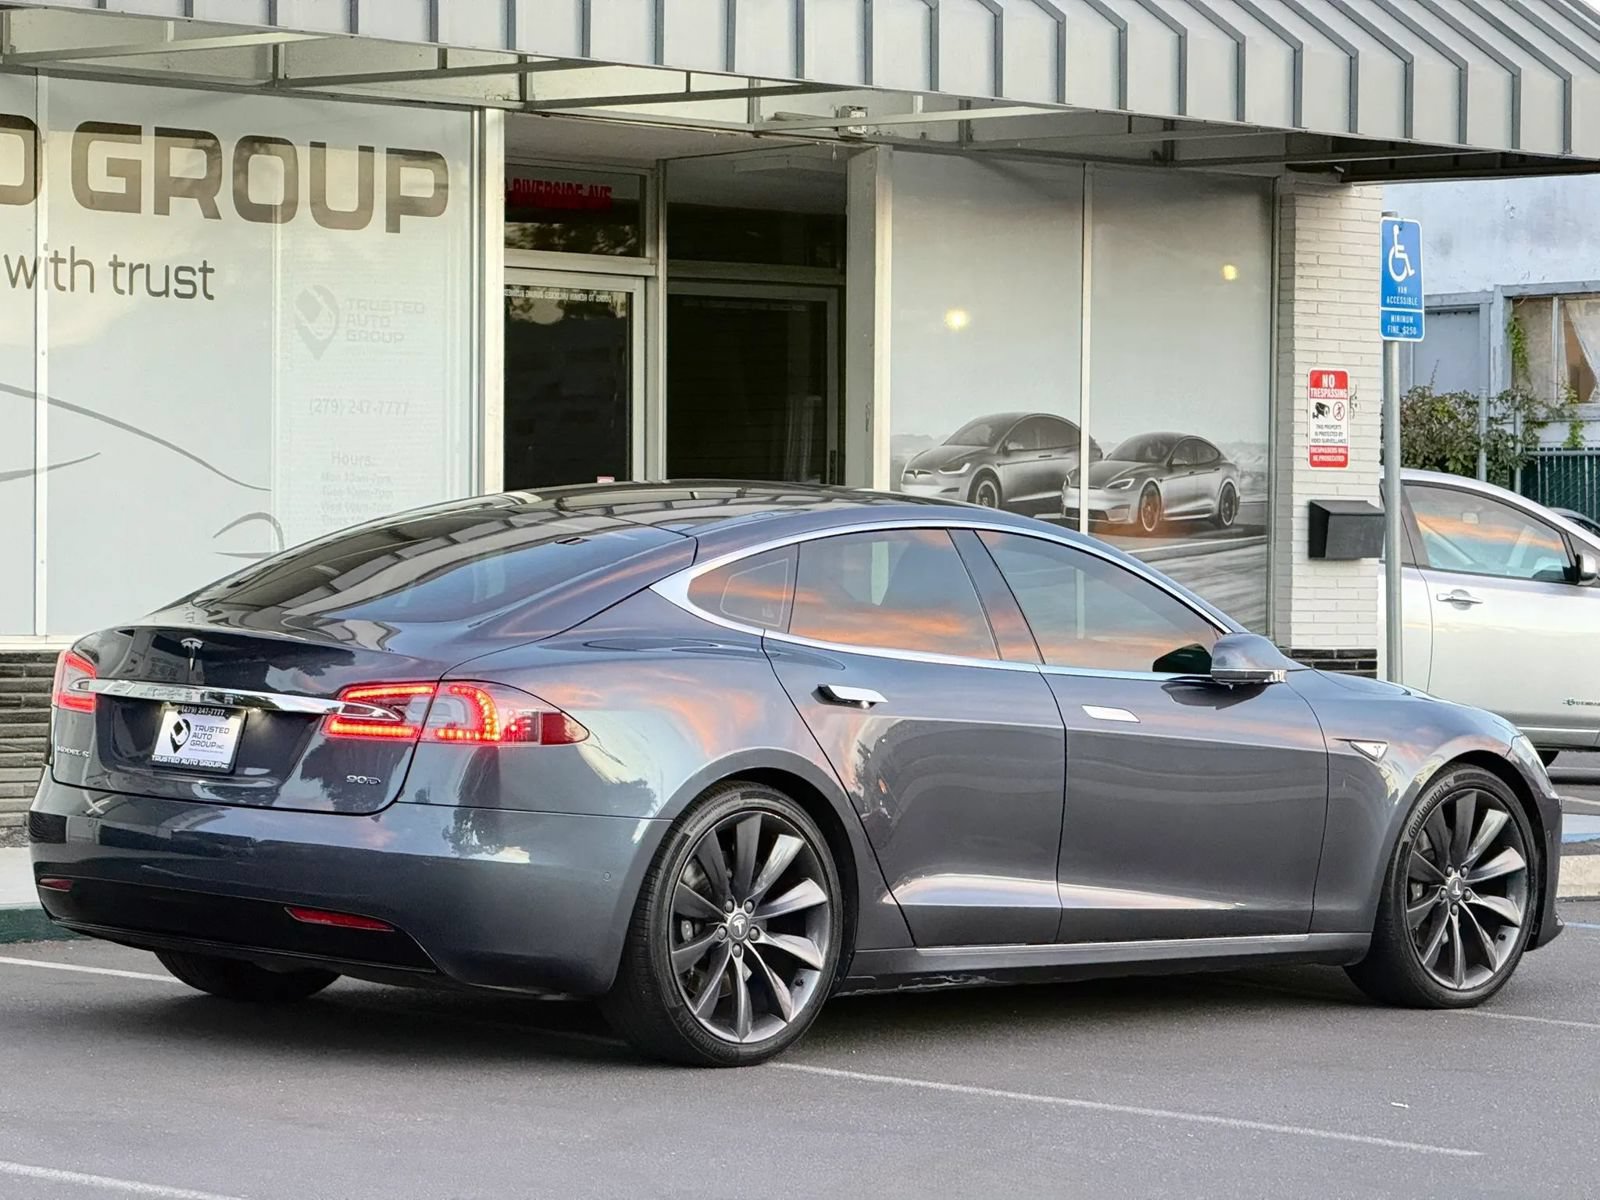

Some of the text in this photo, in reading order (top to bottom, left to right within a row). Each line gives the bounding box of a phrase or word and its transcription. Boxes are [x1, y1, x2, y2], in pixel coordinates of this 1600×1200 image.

[71, 120, 449, 234] GROUP
[4, 245, 215, 302] with trust
[345, 298, 425, 314] TRUSTED
[1386, 296, 1418, 305] ACCESSIBLE
[346, 313, 391, 328] AUTO
[1391, 315, 1413, 323] MINIMUM
[1387, 325, 1417, 335] FINE $250
[346, 329, 404, 344] GROUP
[1322, 374, 1335, 388] NO
[1311, 388, 1348, 398] TRESPASSING
[308, 397, 344, 416] (279)
[181, 705, 225, 717] (279) 247-7777
[194, 724, 230, 734] TRUSTED
[191, 732, 213, 741] AUTO
[189, 740, 216, 748] GROUP
[151, 754, 181, 764] TRUSTED
[180, 757, 199, 766] AUTO
[198, 760, 221, 769] GROUP
[346, 774, 382, 785] 90D
